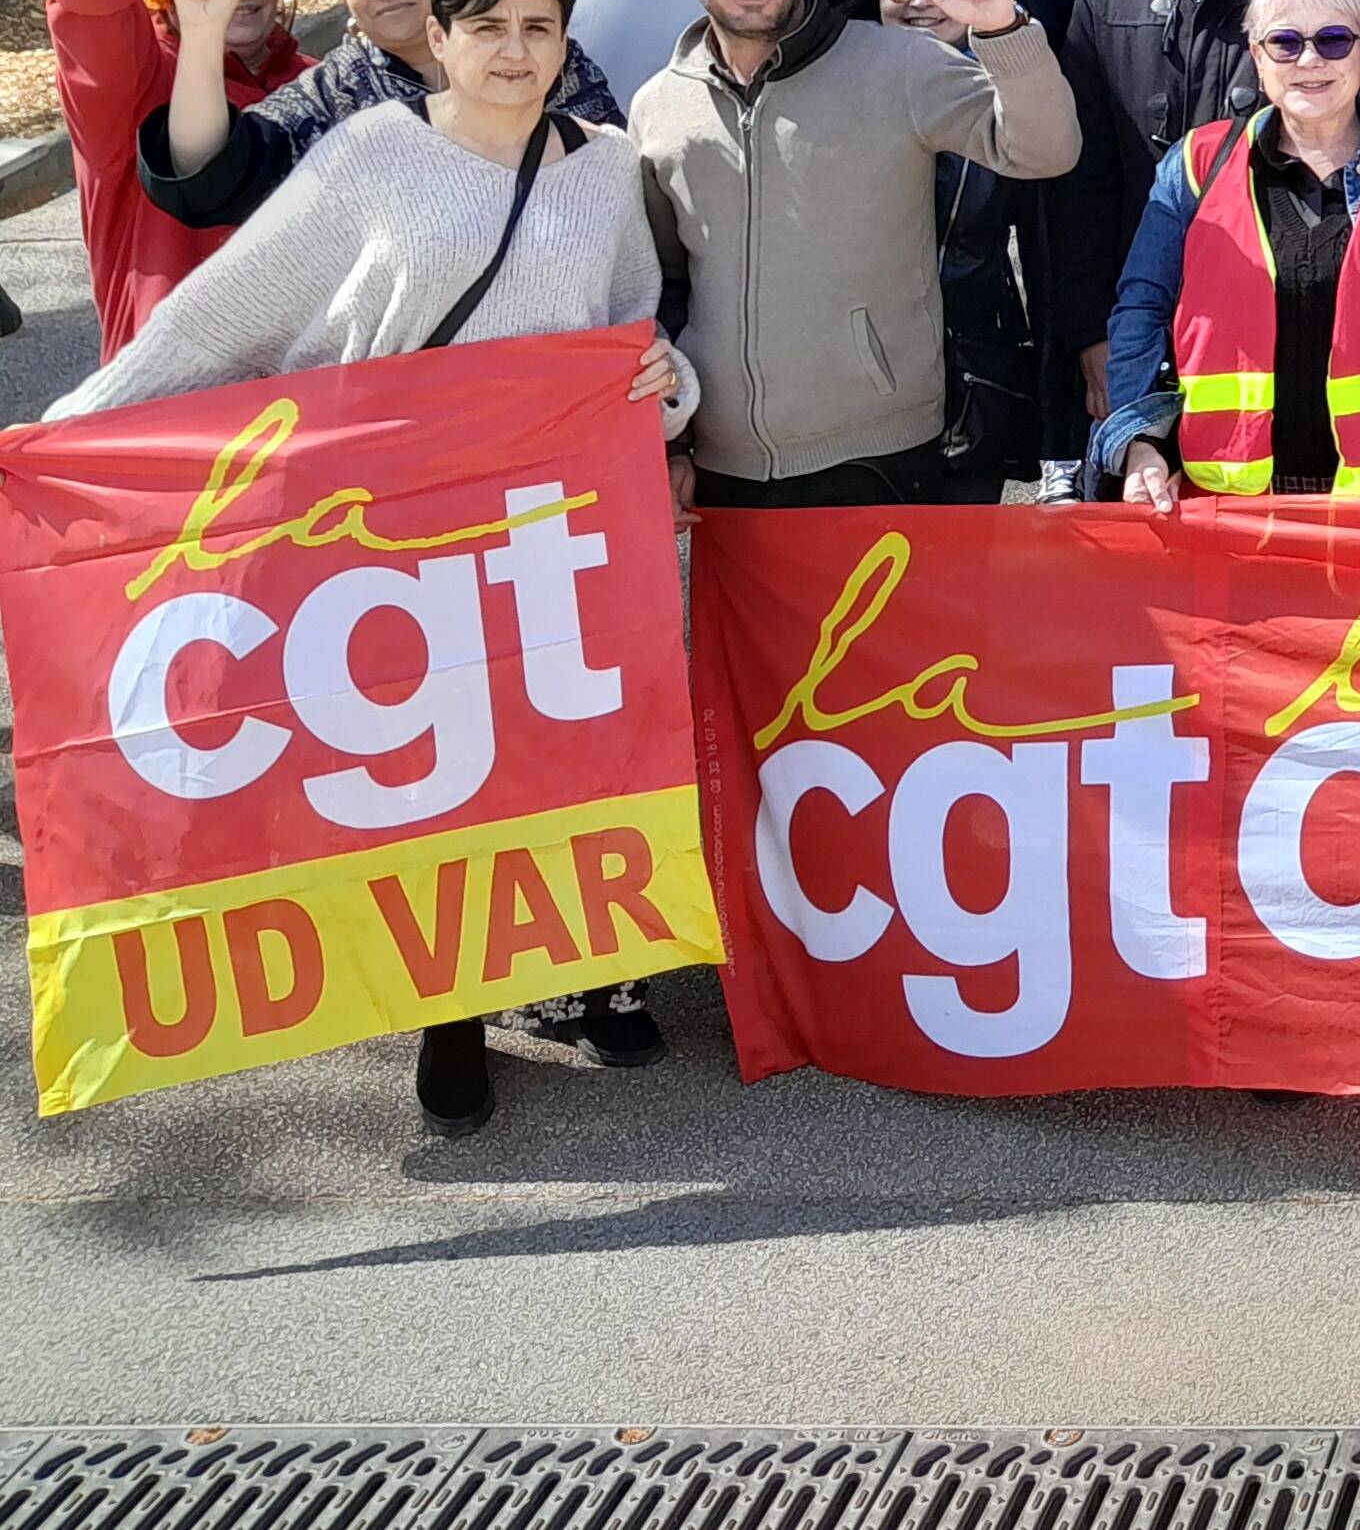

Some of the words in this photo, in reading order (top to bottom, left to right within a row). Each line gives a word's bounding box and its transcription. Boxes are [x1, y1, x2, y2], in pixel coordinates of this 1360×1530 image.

[125, 398, 598, 600] la
[107, 481, 624, 830] cgt
[753, 531, 1200, 751] la
[112, 897, 327, 1059] UD
[368, 826, 677, 1000] VAR
[755, 664, 1210, 1058] cgt
